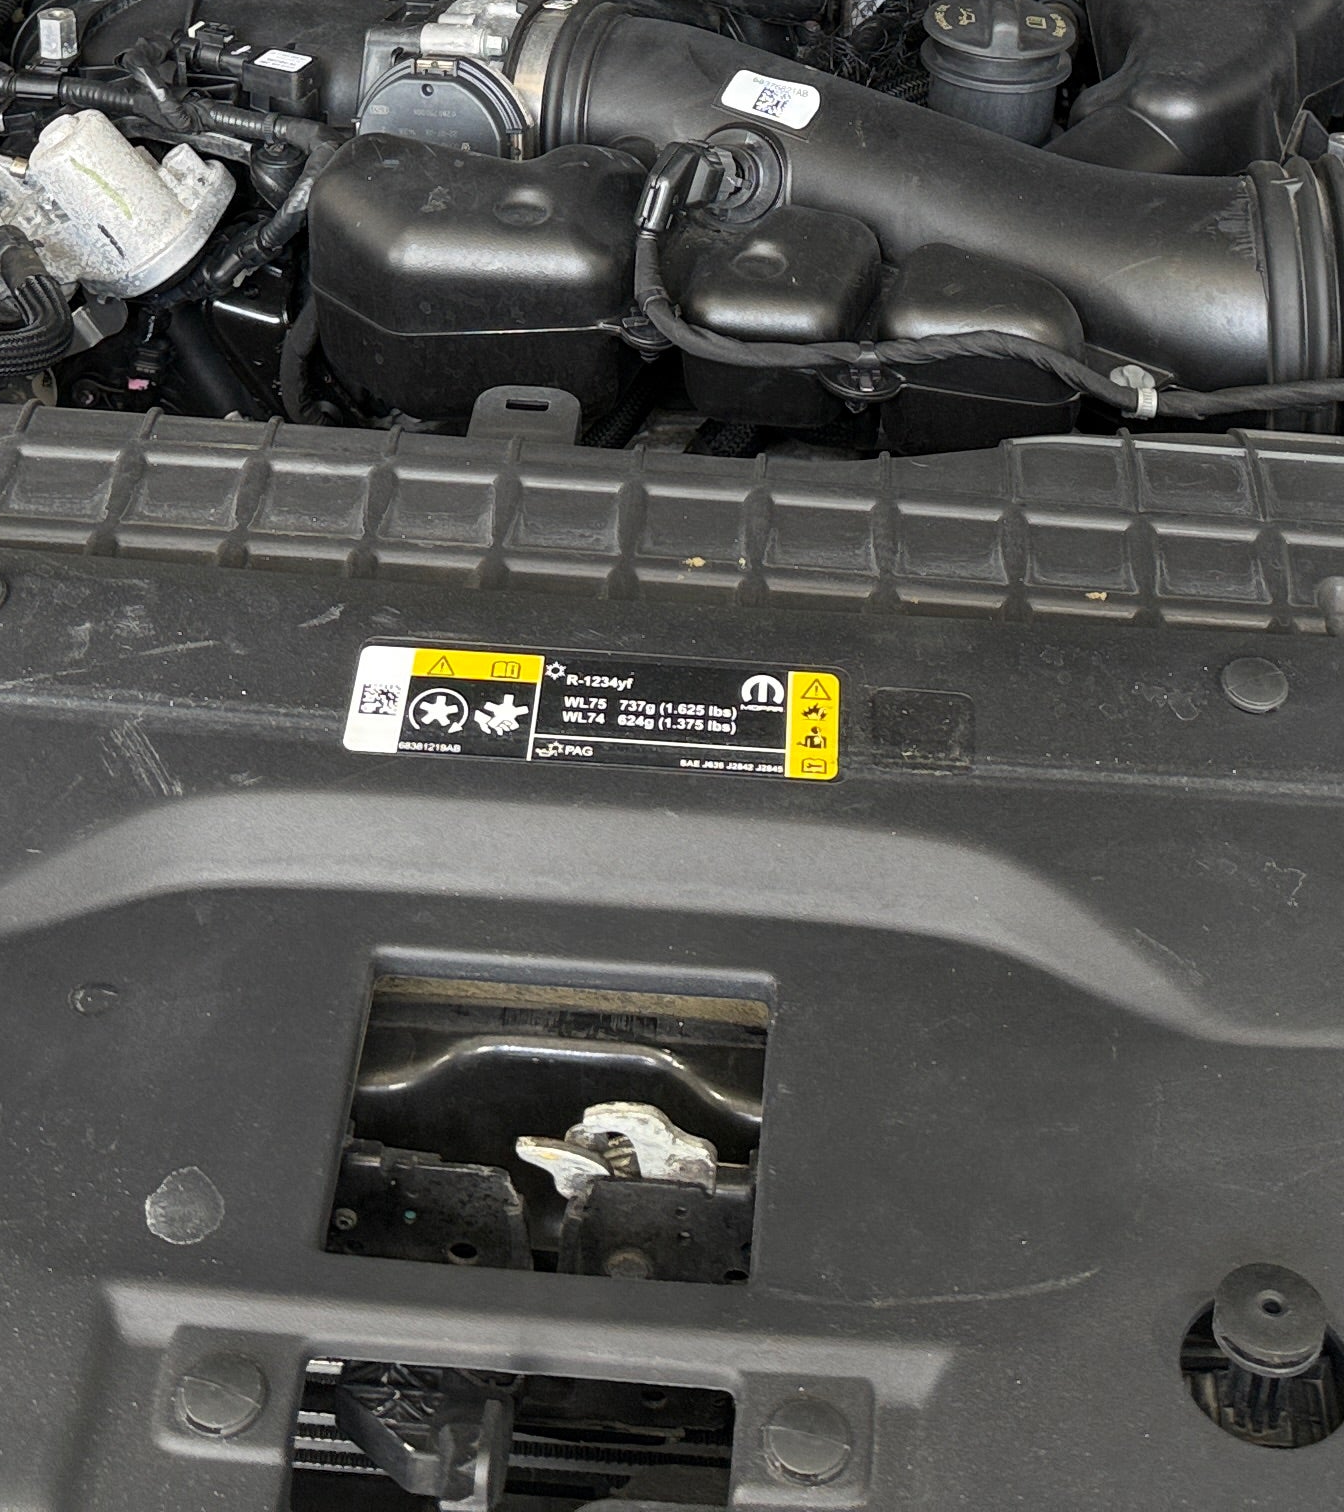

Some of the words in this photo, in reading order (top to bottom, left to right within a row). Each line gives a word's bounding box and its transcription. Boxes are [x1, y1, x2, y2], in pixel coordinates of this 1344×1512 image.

[566, 674, 636, 692] R-1234yf
[563, 695, 608, 710] WL75
[618, 699, 656, 716] 737g
[659, 701, 706, 717] (1.625
[708, 704, 739, 721] lbs)
[561, 710, 606, 725] WL74
[616, 714, 655, 731] 624g
[657, 716, 705, 732] (1.375
[707, 719, 737, 735] lbs)
[563, 744, 594, 757] PAG
[679, 758, 701, 768] SAE
